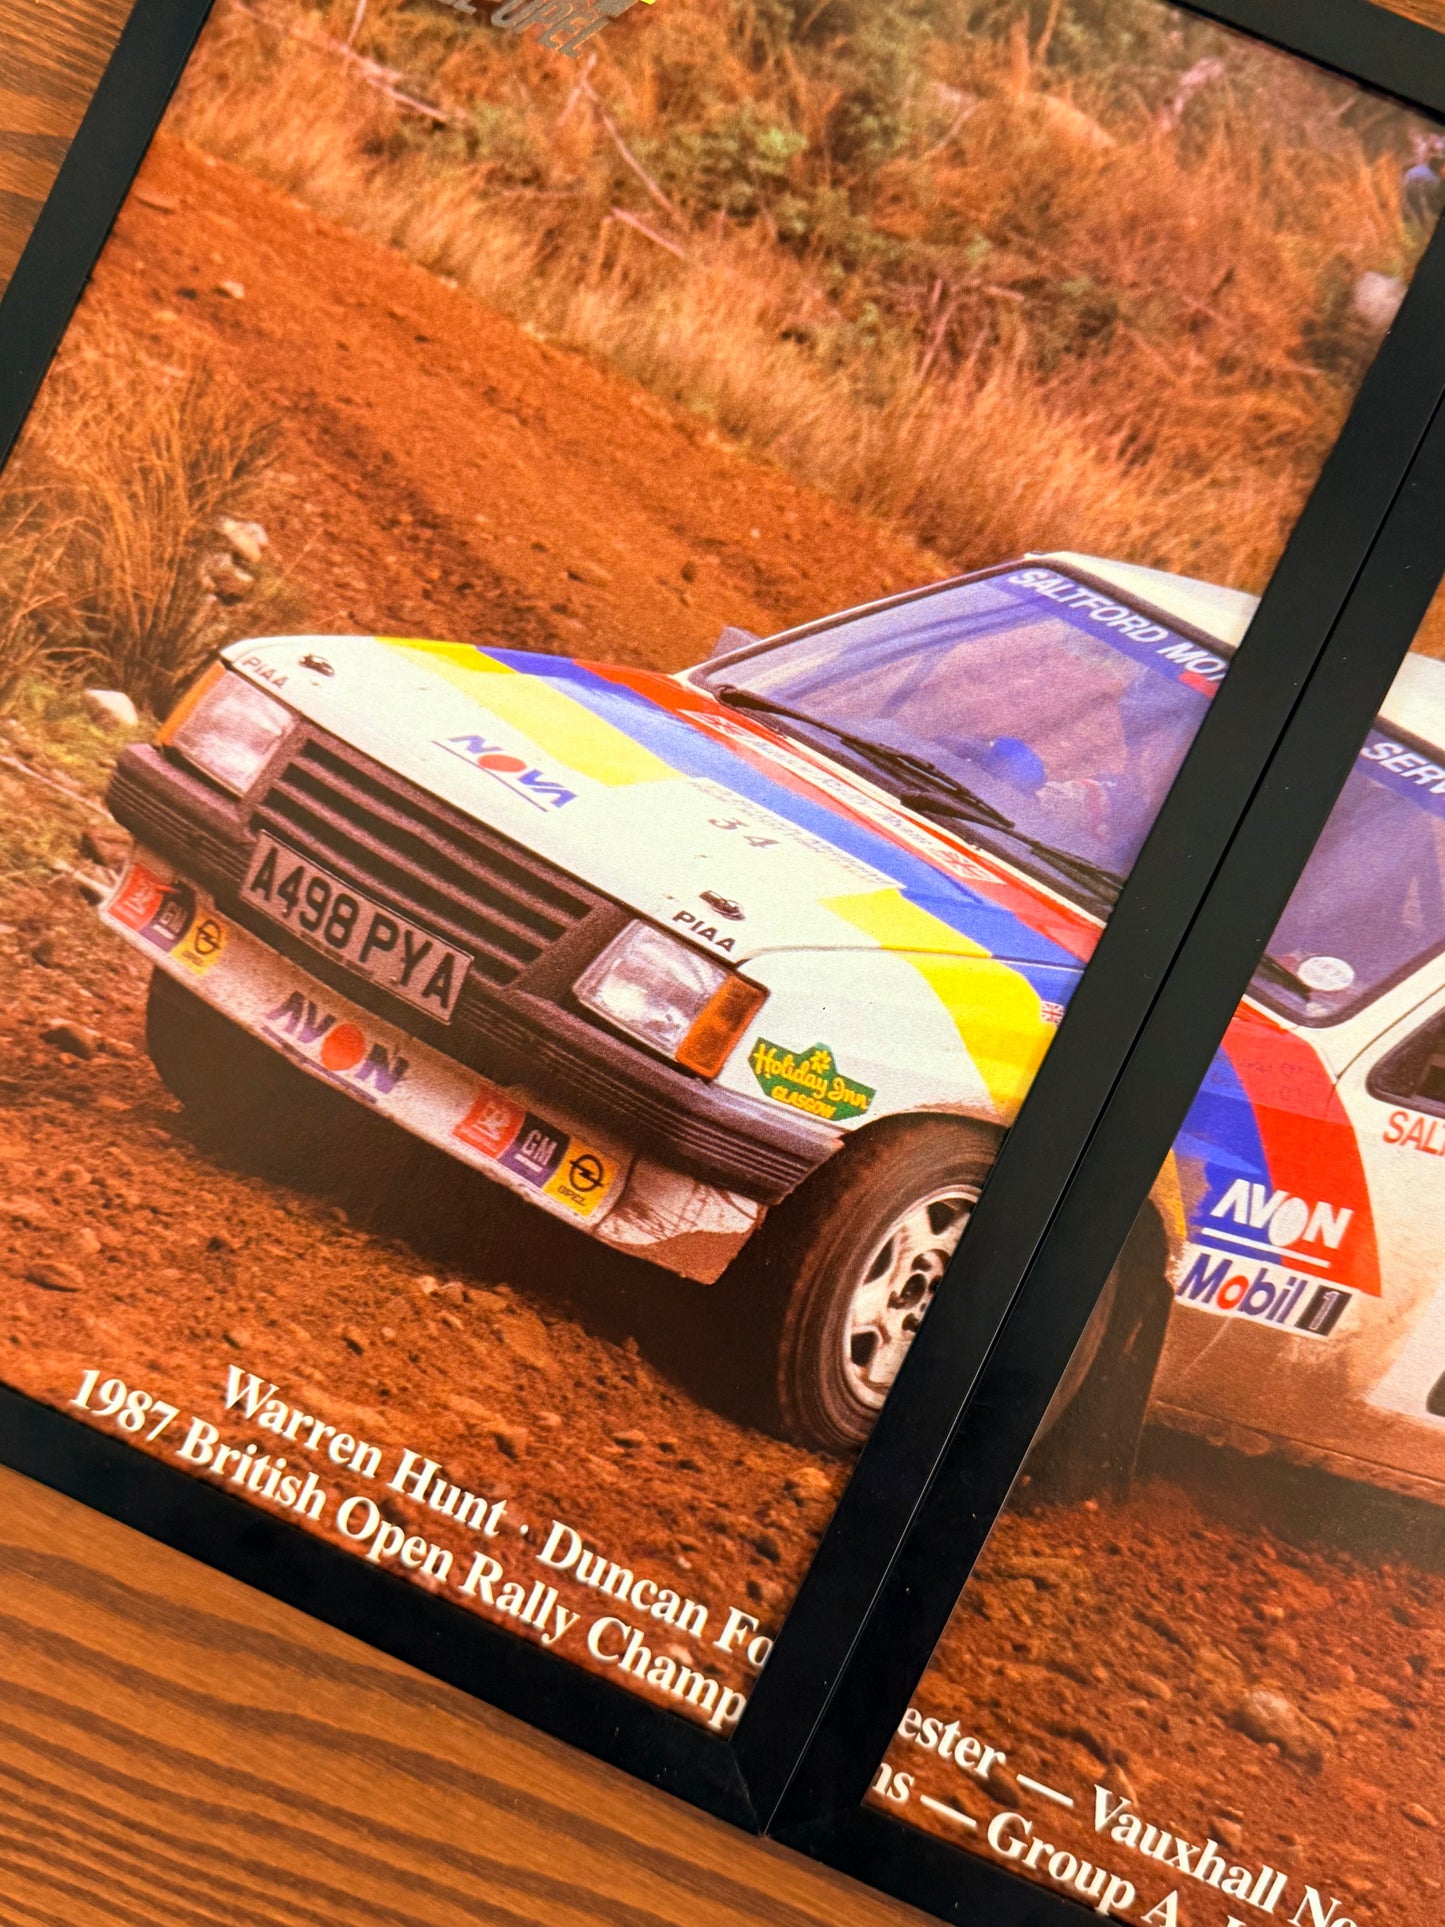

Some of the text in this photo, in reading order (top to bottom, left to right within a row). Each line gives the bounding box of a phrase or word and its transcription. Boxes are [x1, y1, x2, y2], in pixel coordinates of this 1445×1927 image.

[1008, 570, 1170, 643] SALTFORD
[242, 656, 288, 689] PIAA
[447, 735, 577, 808] NOVA
[250, 846, 360, 950] A498
[358, 912, 456, 1010] PYA
[672, 910, 736, 952] PIAA
[265, 990, 410, 1094] AVON
[753, 1043, 869, 1111] Holiday Inn
[520, 1129, 558, 1166] GM
[1210, 1178, 1355, 1250] AVON
[1176, 1252, 1342, 1331] Mobil 1
[69, 1369, 749, 1731] 1987 British Open Rally Champ
[224, 1364, 383, 1480] Warren
[387, 1448, 508, 1537] Hunt
[535, 1519, 709, 1638] Duncan
[713, 1606, 774, 1668] Fo
[898, 1707, 1006, 1779] ester
[1093, 1783, 1289, 1915] Vauxhall
[986, 1810, 1136, 1915] Group
